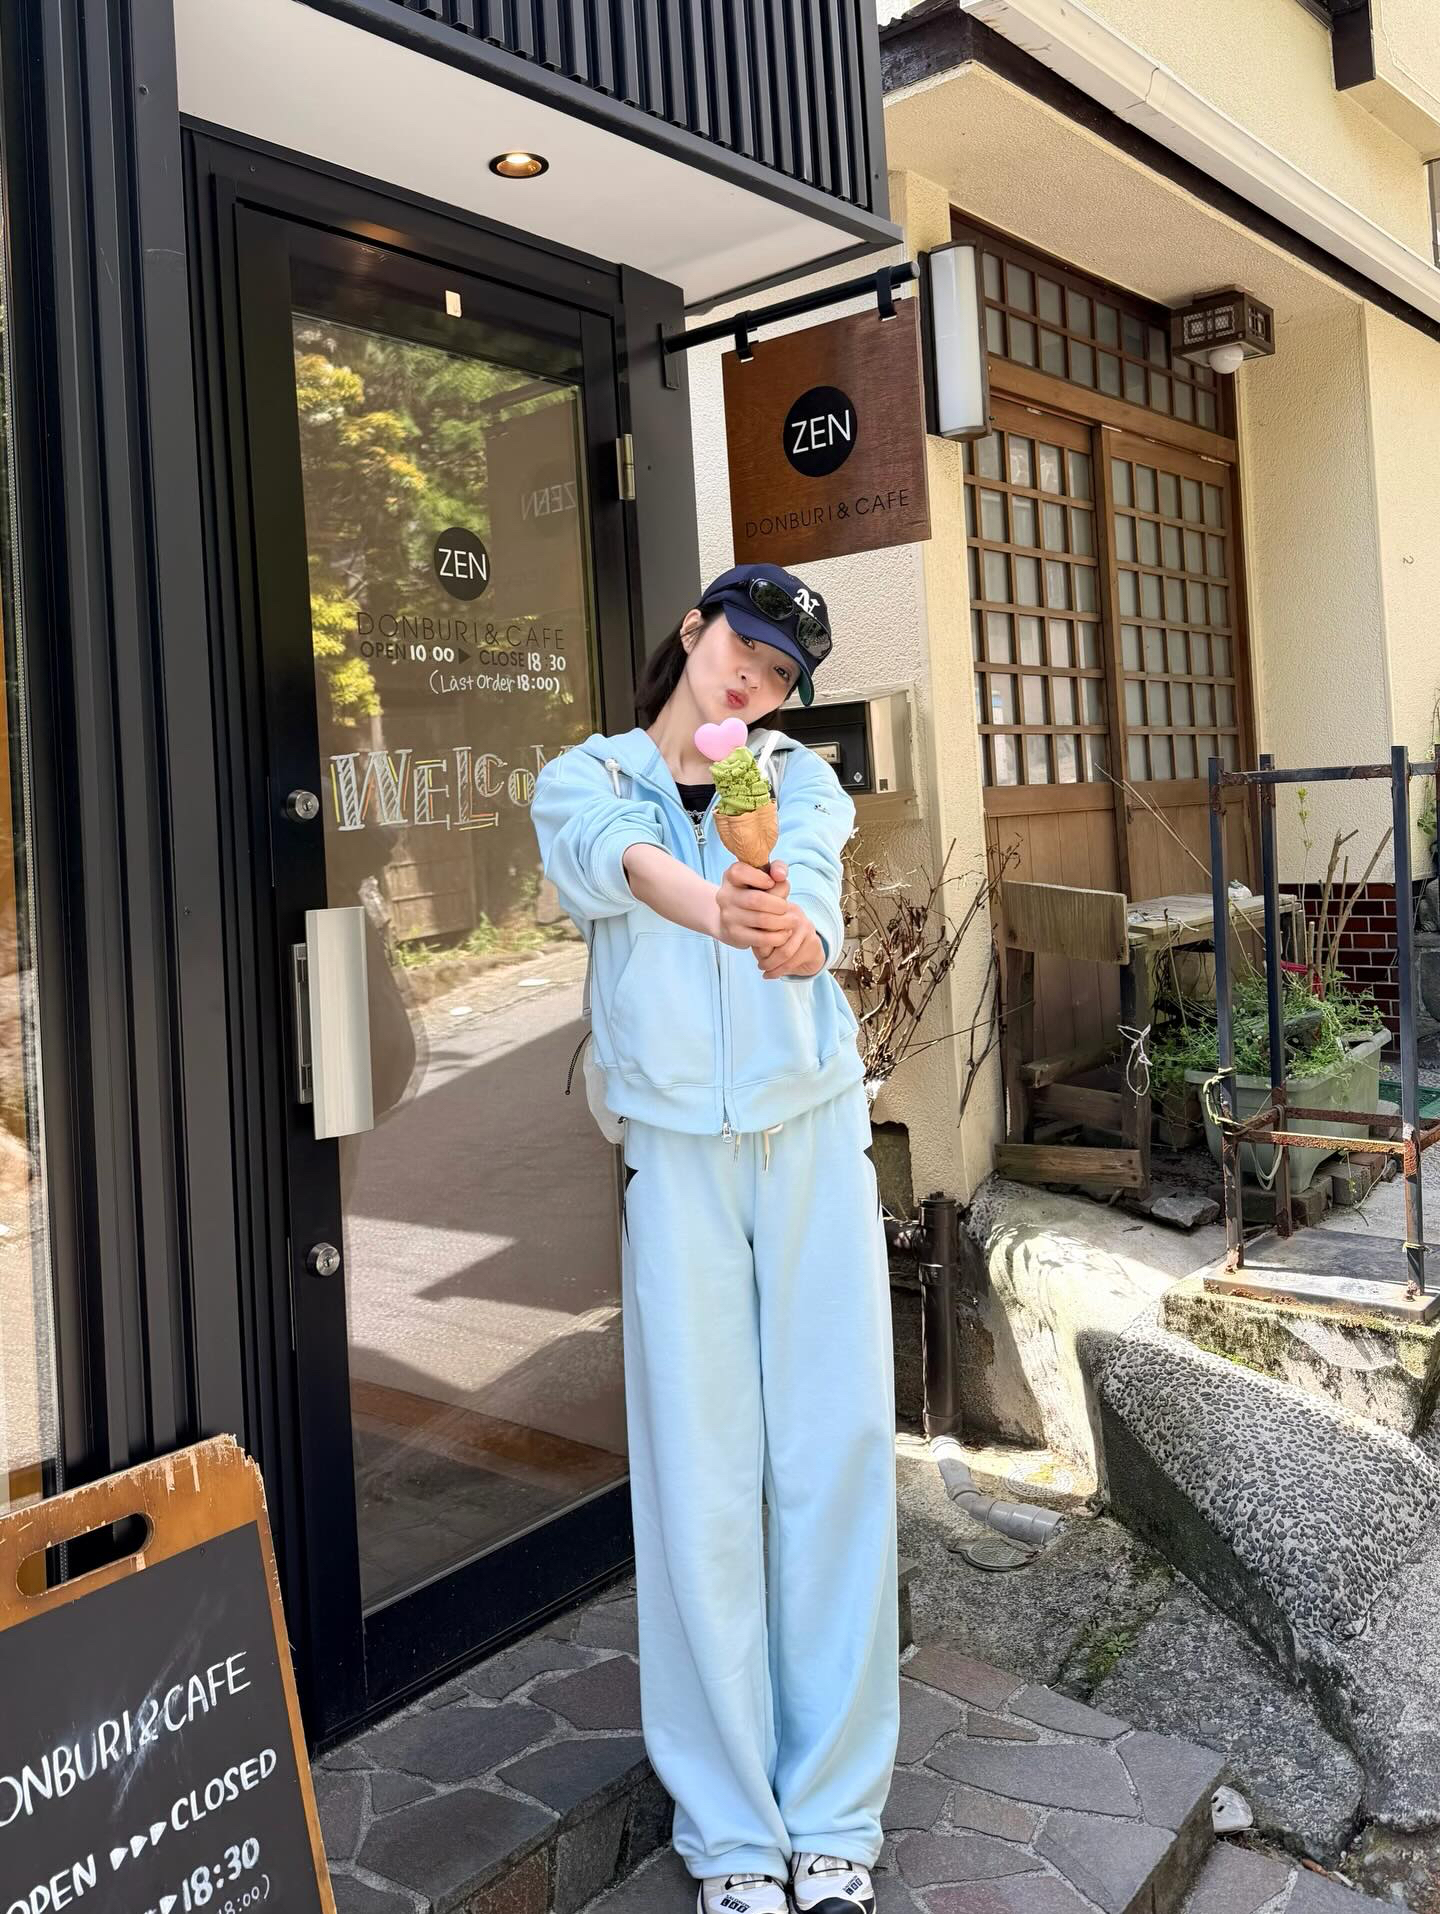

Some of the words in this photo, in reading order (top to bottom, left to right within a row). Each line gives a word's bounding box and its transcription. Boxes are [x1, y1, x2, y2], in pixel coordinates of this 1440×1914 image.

[791, 409, 851, 454] ZEN
[438, 547, 488, 581] ZEN
[360, 640, 407, 660] OPEN
[479, 649, 526, 668] CLOSE
[171, 1748, 277, 1831] CLOSED
[182, 1837, 260, 1912] 18:30
